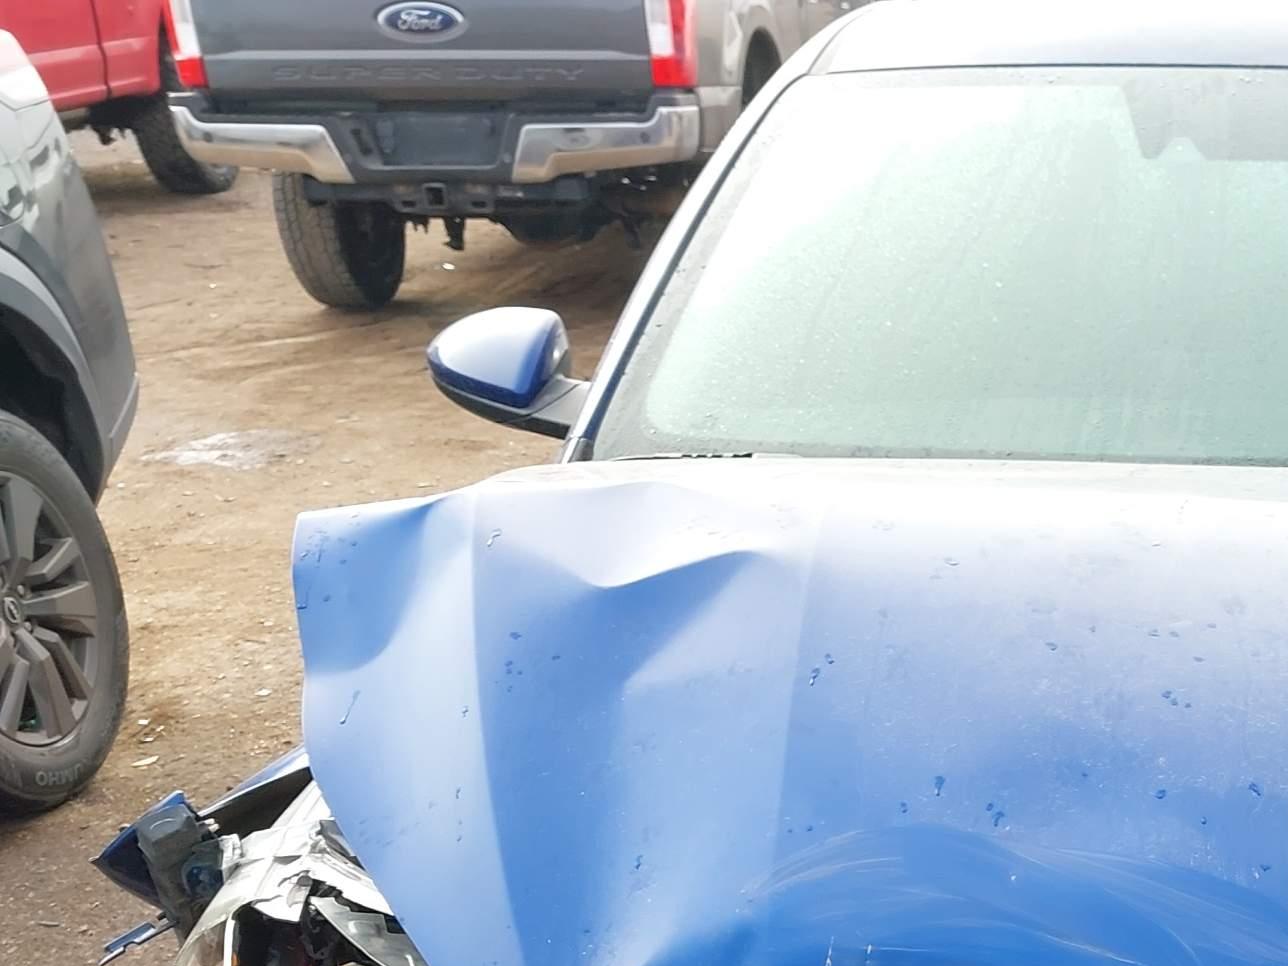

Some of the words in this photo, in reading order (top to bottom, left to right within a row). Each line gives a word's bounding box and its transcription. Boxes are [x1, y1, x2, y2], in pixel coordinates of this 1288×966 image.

[398, 9, 443, 30] Ford
[272, 65, 441, 81] SUPER
[455, 66, 585, 81] DUTY
